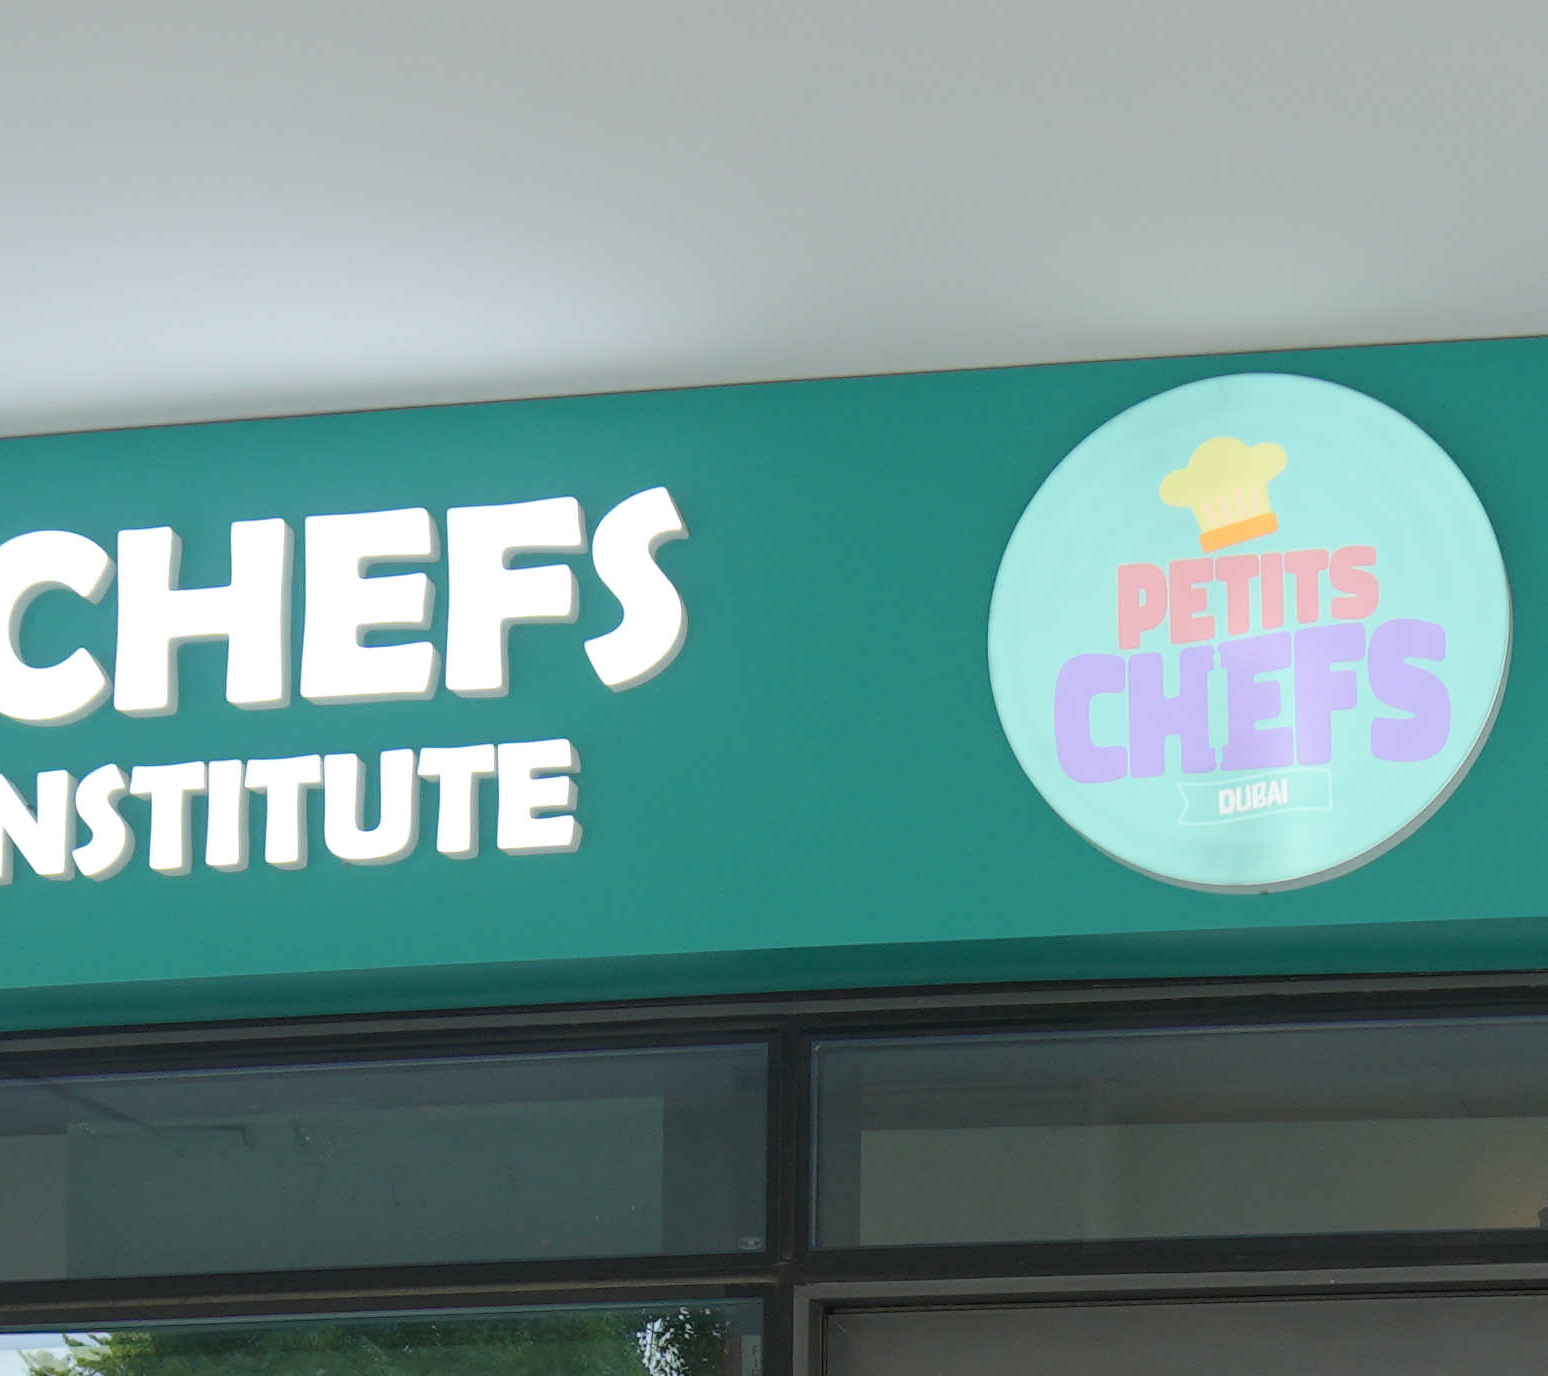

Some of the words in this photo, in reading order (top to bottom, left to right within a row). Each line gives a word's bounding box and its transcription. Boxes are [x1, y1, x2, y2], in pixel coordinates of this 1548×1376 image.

[1117, 545, 1380, 650] PETITS
[1054, 618, 1451, 784] CHEFS
[1218, 778, 1289, 816] DUBAI
